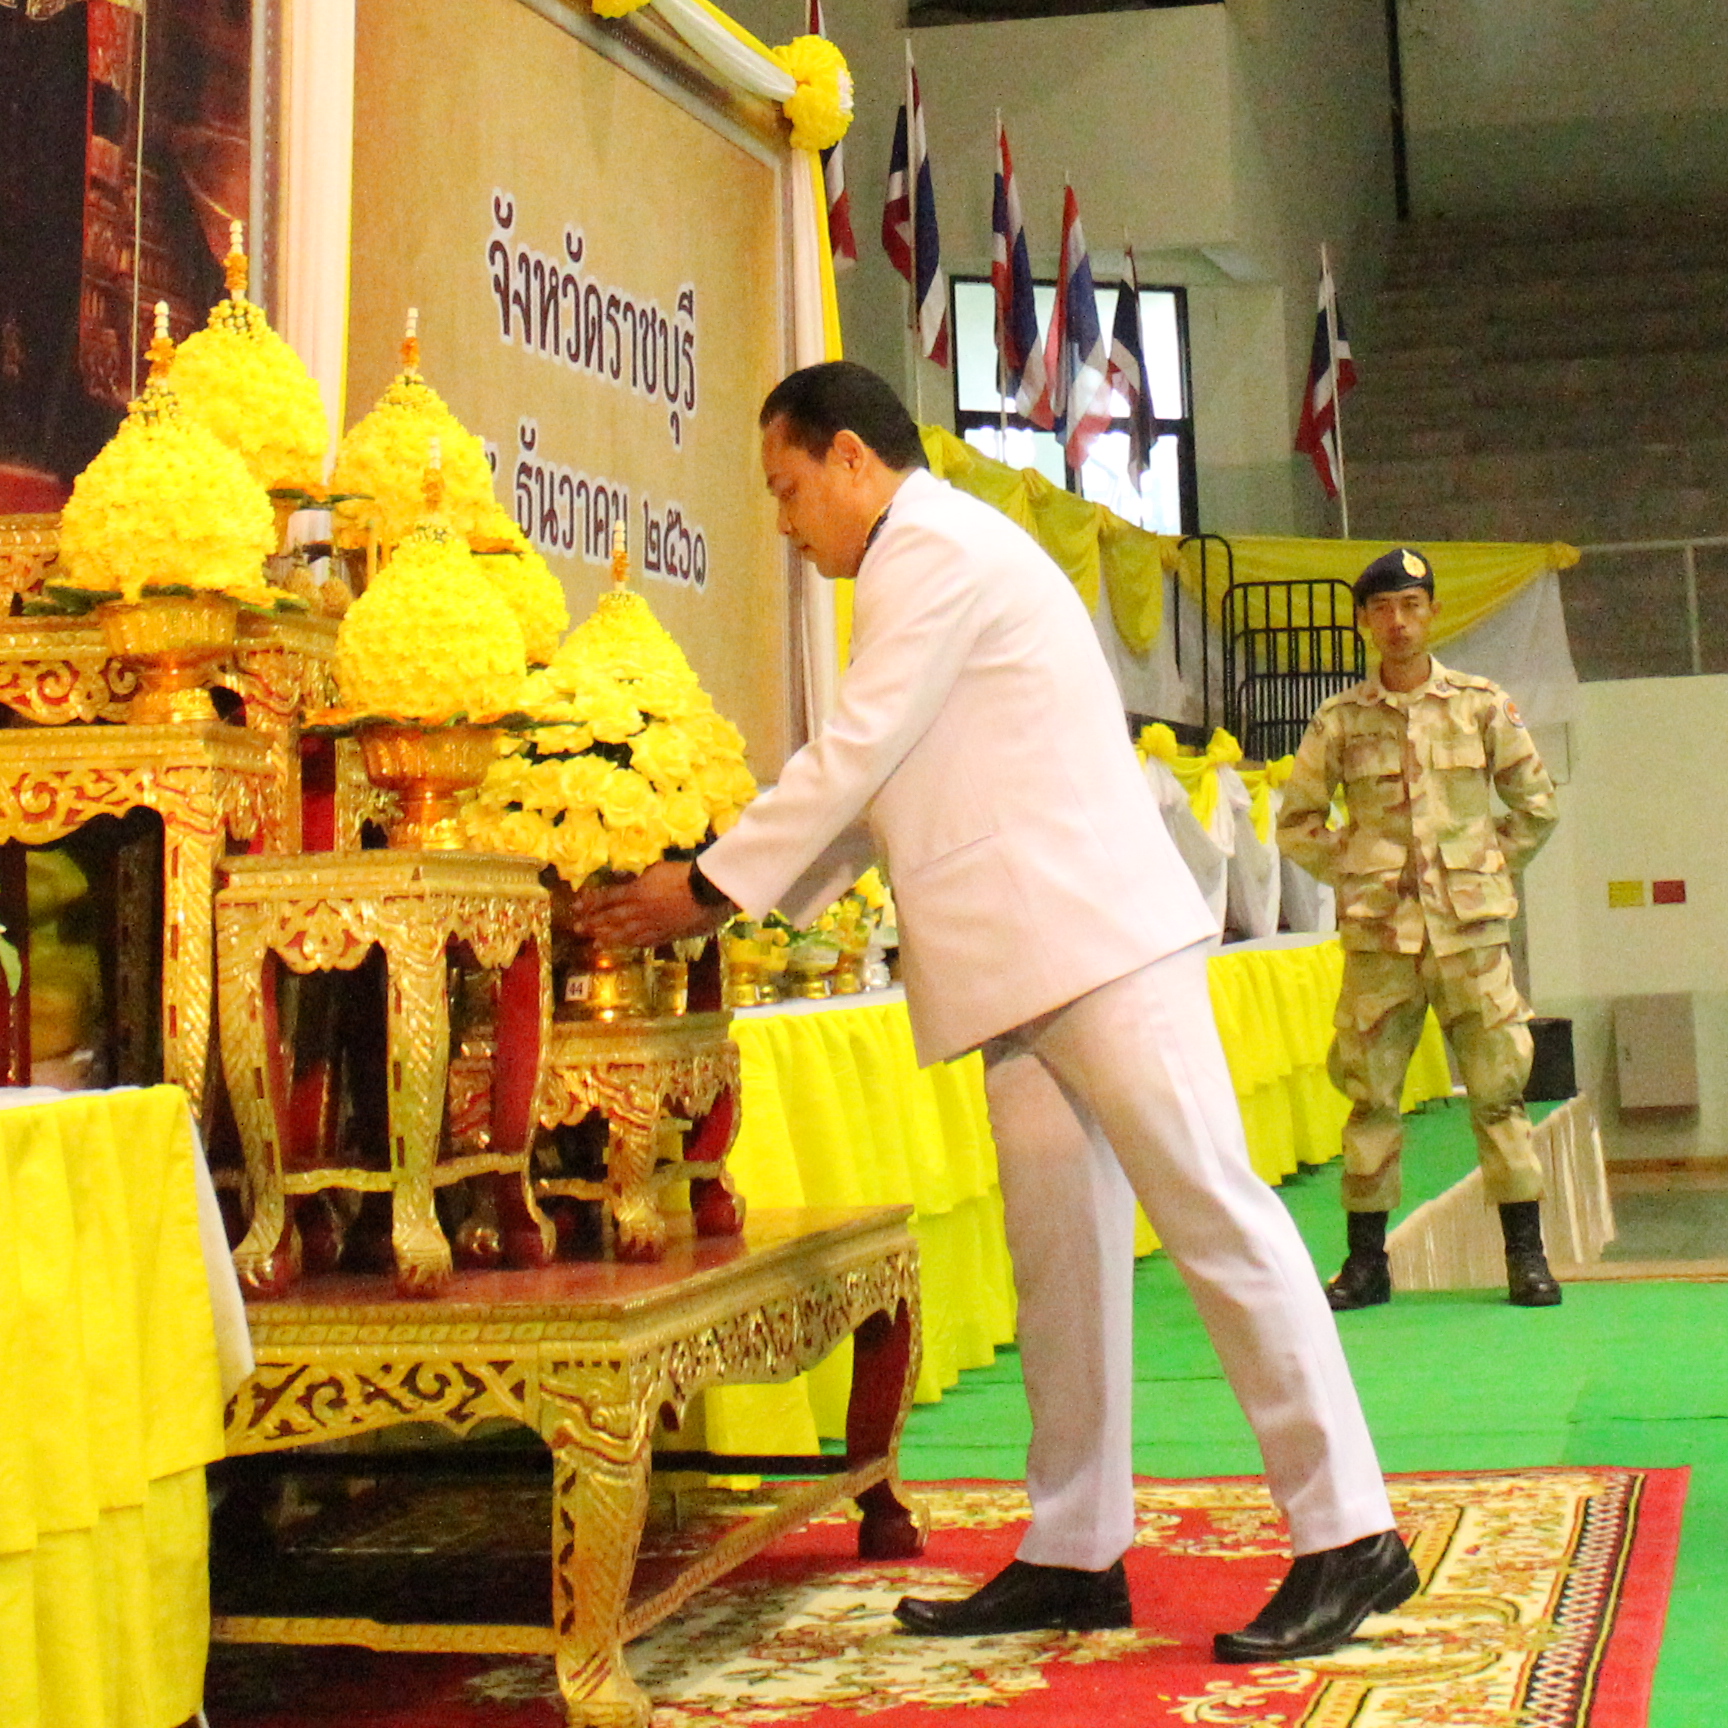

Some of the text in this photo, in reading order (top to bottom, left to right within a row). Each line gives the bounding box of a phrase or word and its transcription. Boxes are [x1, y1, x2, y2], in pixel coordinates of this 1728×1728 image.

[489, 195, 695, 445] จังหวัดราชบุรี
[643, 500, 706, 586] ๒๕๖๑
